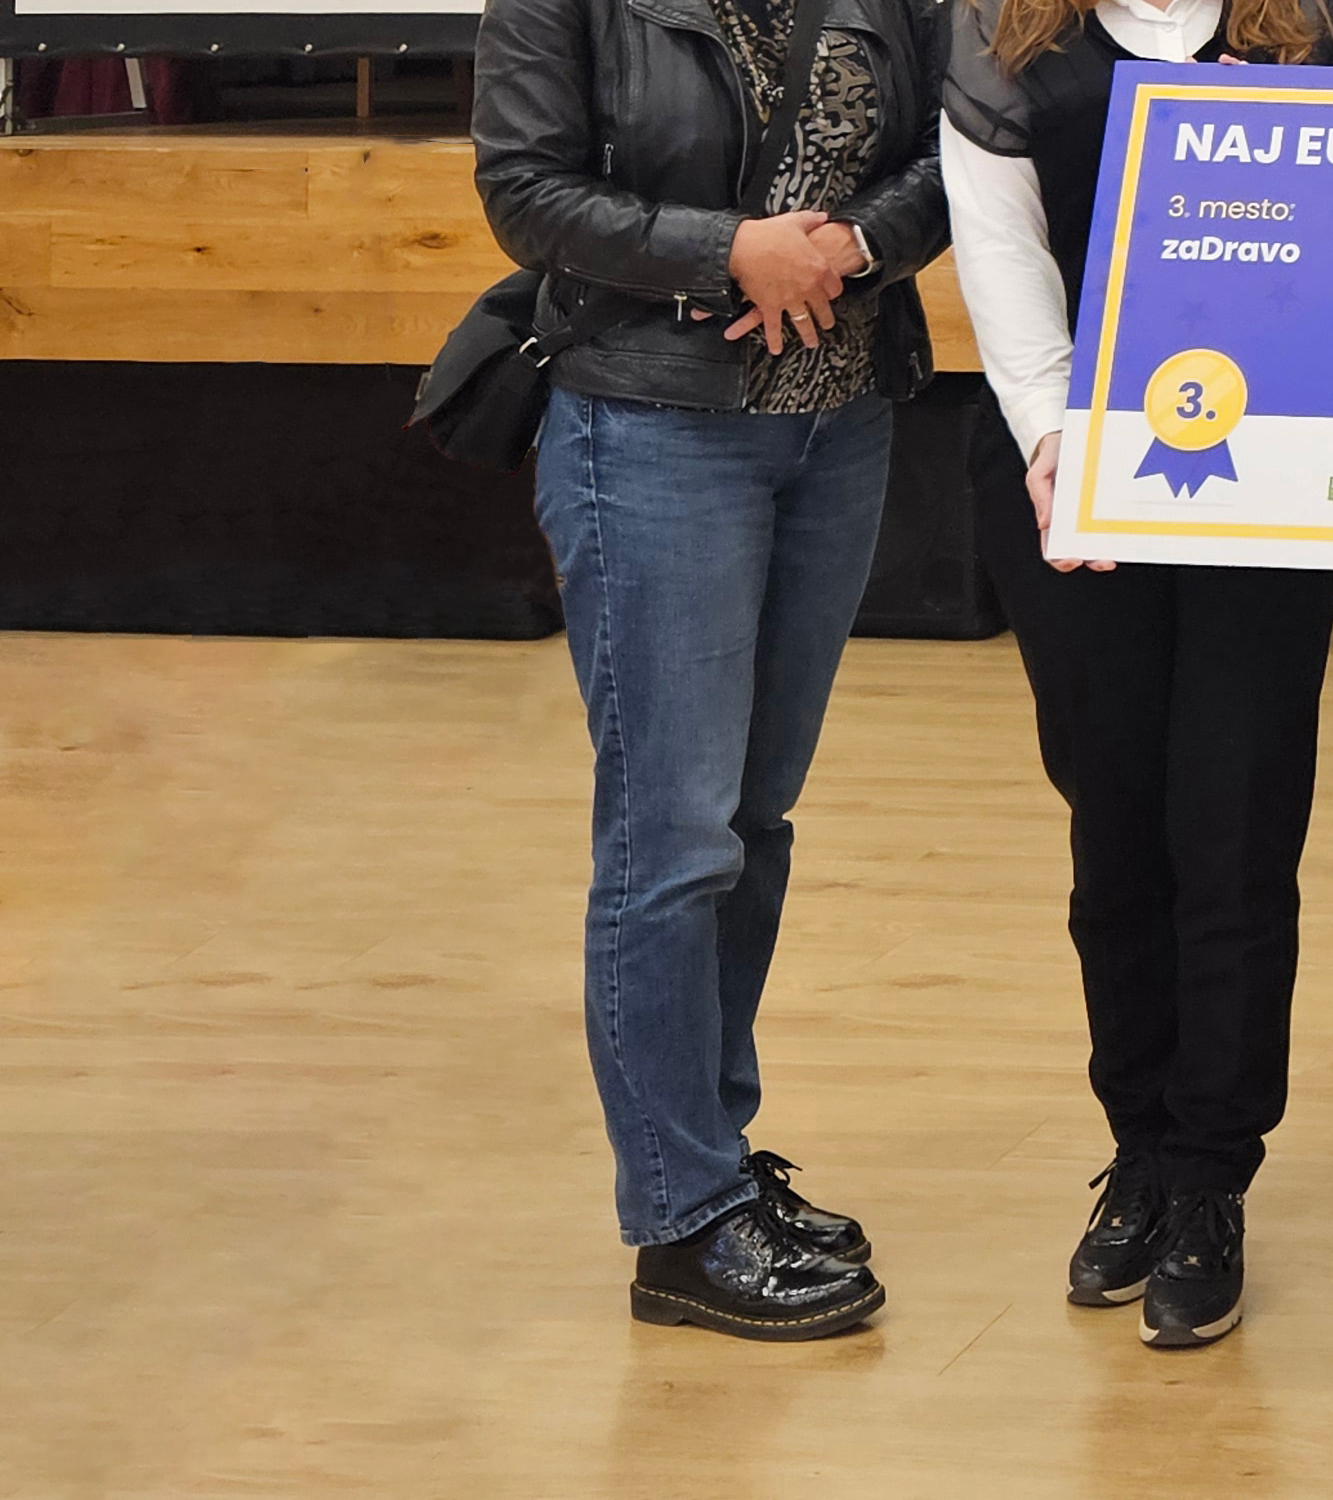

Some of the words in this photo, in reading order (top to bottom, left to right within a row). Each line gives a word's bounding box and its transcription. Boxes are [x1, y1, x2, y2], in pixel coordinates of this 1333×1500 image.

[1173, 122, 1285, 164] NAJ
[1168, 195, 1191, 218] 3.
[1199, 197, 1296, 223] mesto:
[1161, 236, 1301, 264] zaDravo
[1176, 381, 1216, 420] 3.
